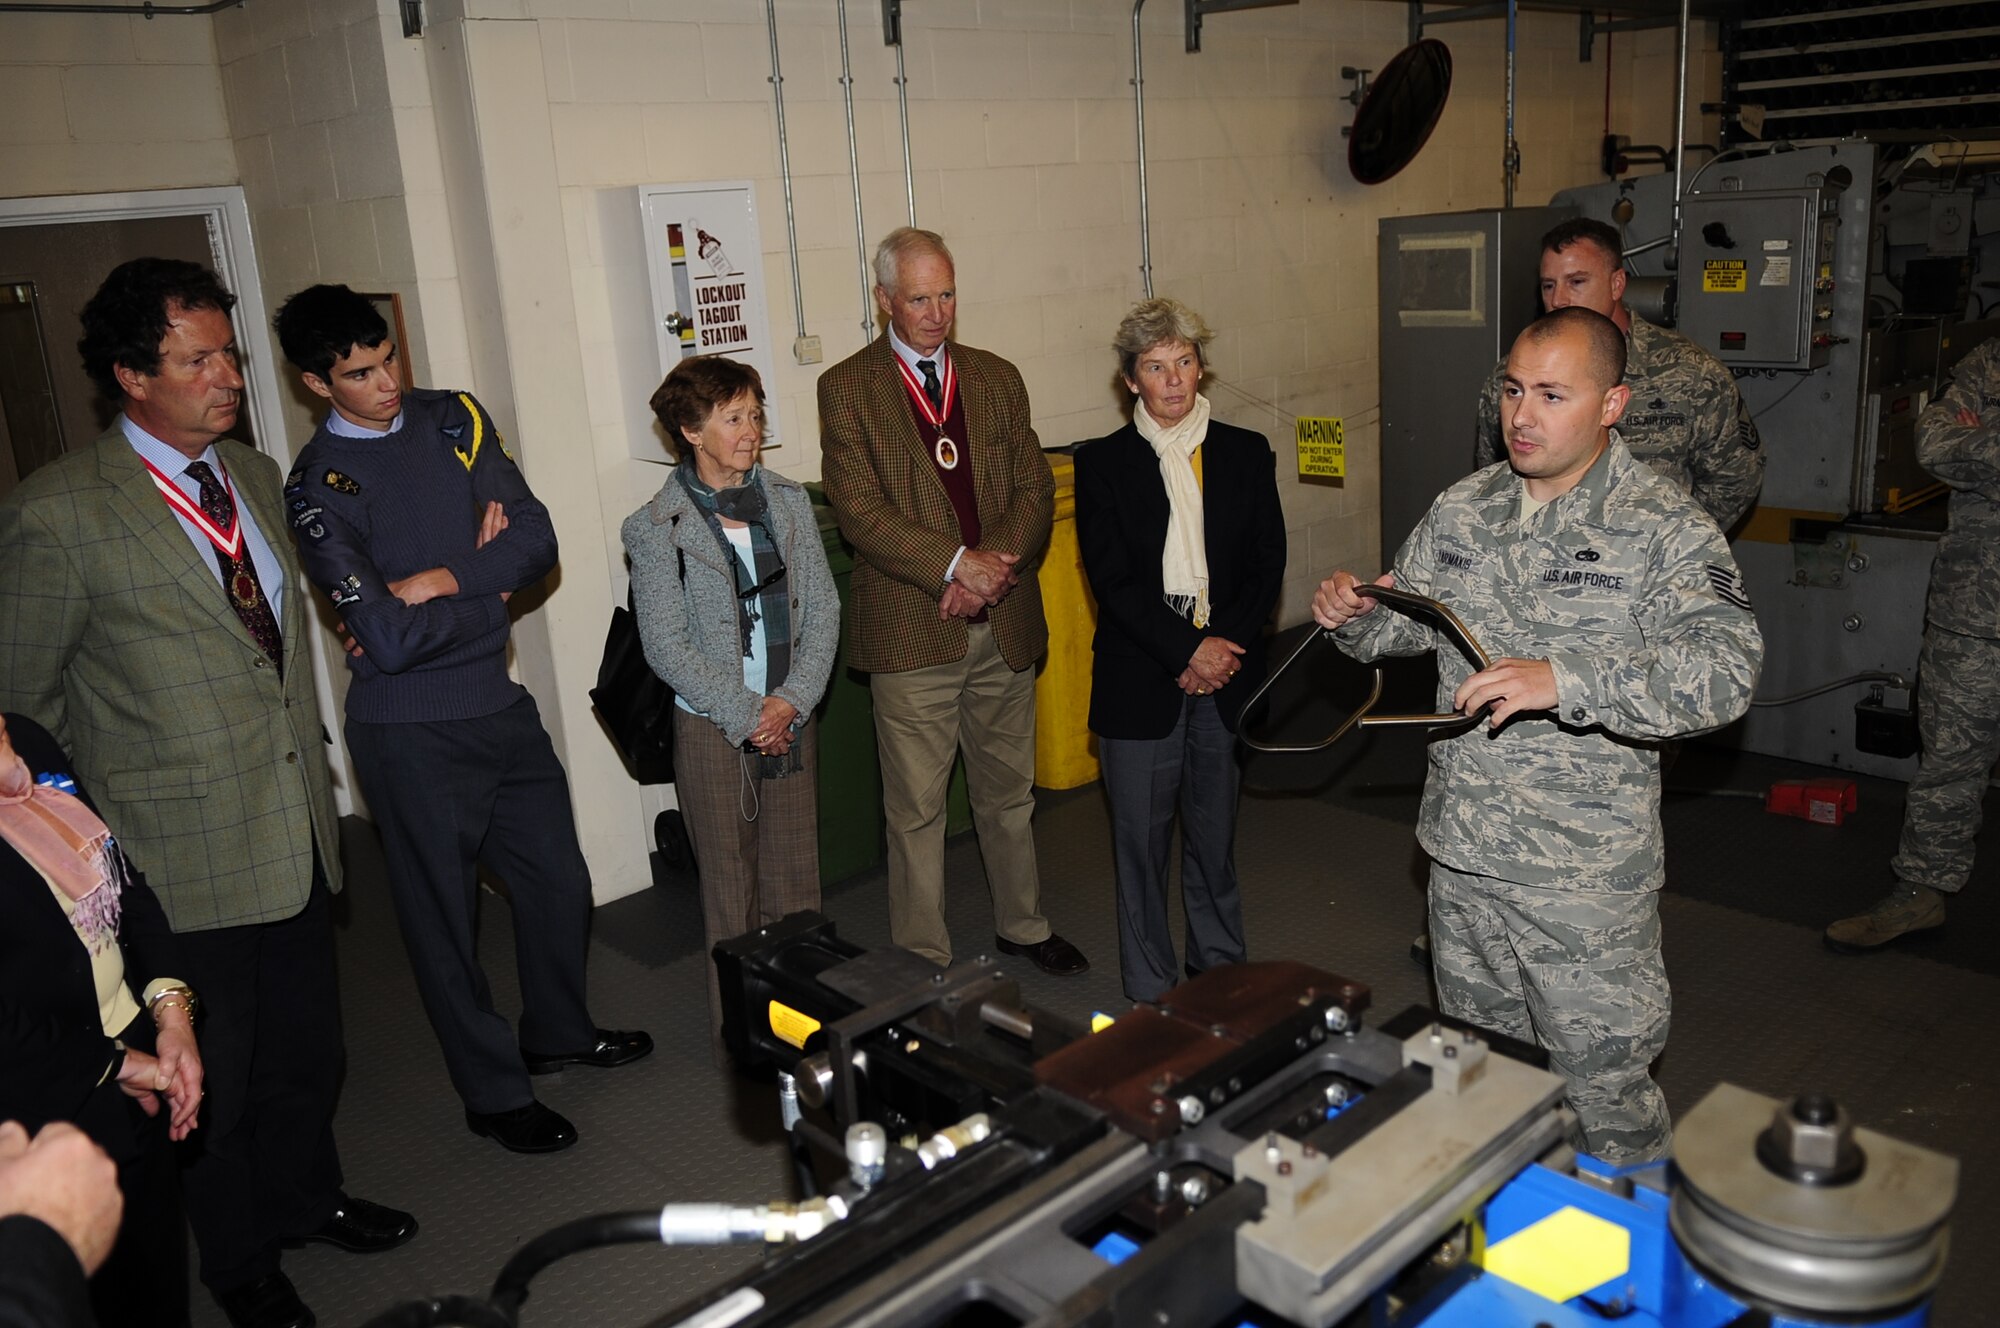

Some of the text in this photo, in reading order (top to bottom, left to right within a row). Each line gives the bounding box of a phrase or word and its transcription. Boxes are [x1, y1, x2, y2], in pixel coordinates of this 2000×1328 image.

[1706, 260, 1744, 269] CAUTION
[696, 283, 746, 305] LOCKOUT
[698, 305, 741, 326] TAGOUT
[701, 324, 748, 347] STATION
[1643, 416, 1658, 426] AIR
[1660, 416, 1685, 426] FORCE
[1297, 419, 1343, 445] WARNING
[1300, 446, 1343, 456] DO NOT ENTER
[1310, 455, 1333, 464] DURING
[1305, 464, 1339, 474] OPERATION
[1543, 569, 1624, 590] U.S. AIR FORCE
